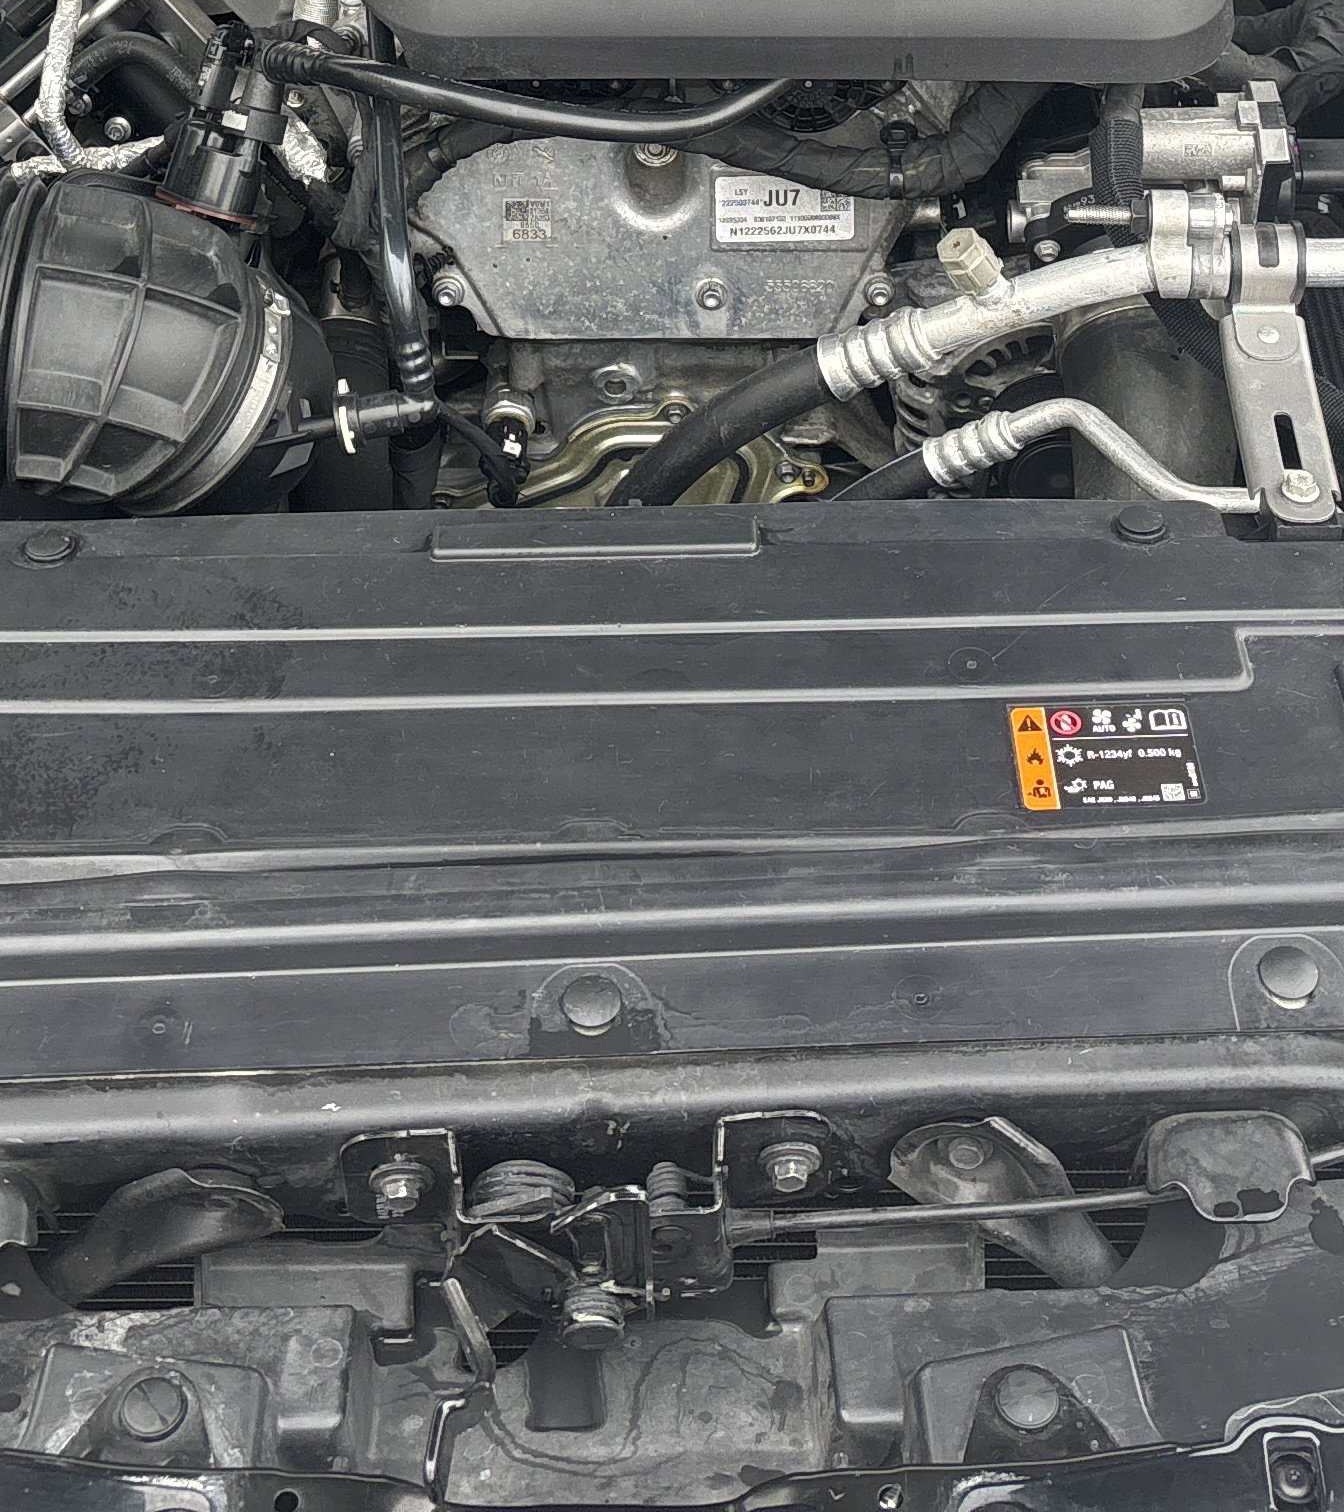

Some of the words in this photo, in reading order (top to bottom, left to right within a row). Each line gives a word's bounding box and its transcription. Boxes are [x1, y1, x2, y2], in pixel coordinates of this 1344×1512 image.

[763, 189, 801, 207] JU7
[512, 228, 548, 240] 6833
[1092, 724, 1117, 733] AUTO
[1086, 749, 1133, 760] R-1234yf
[1168, 747, 1182, 758] kg
[1092, 780, 1115, 790] PAG
